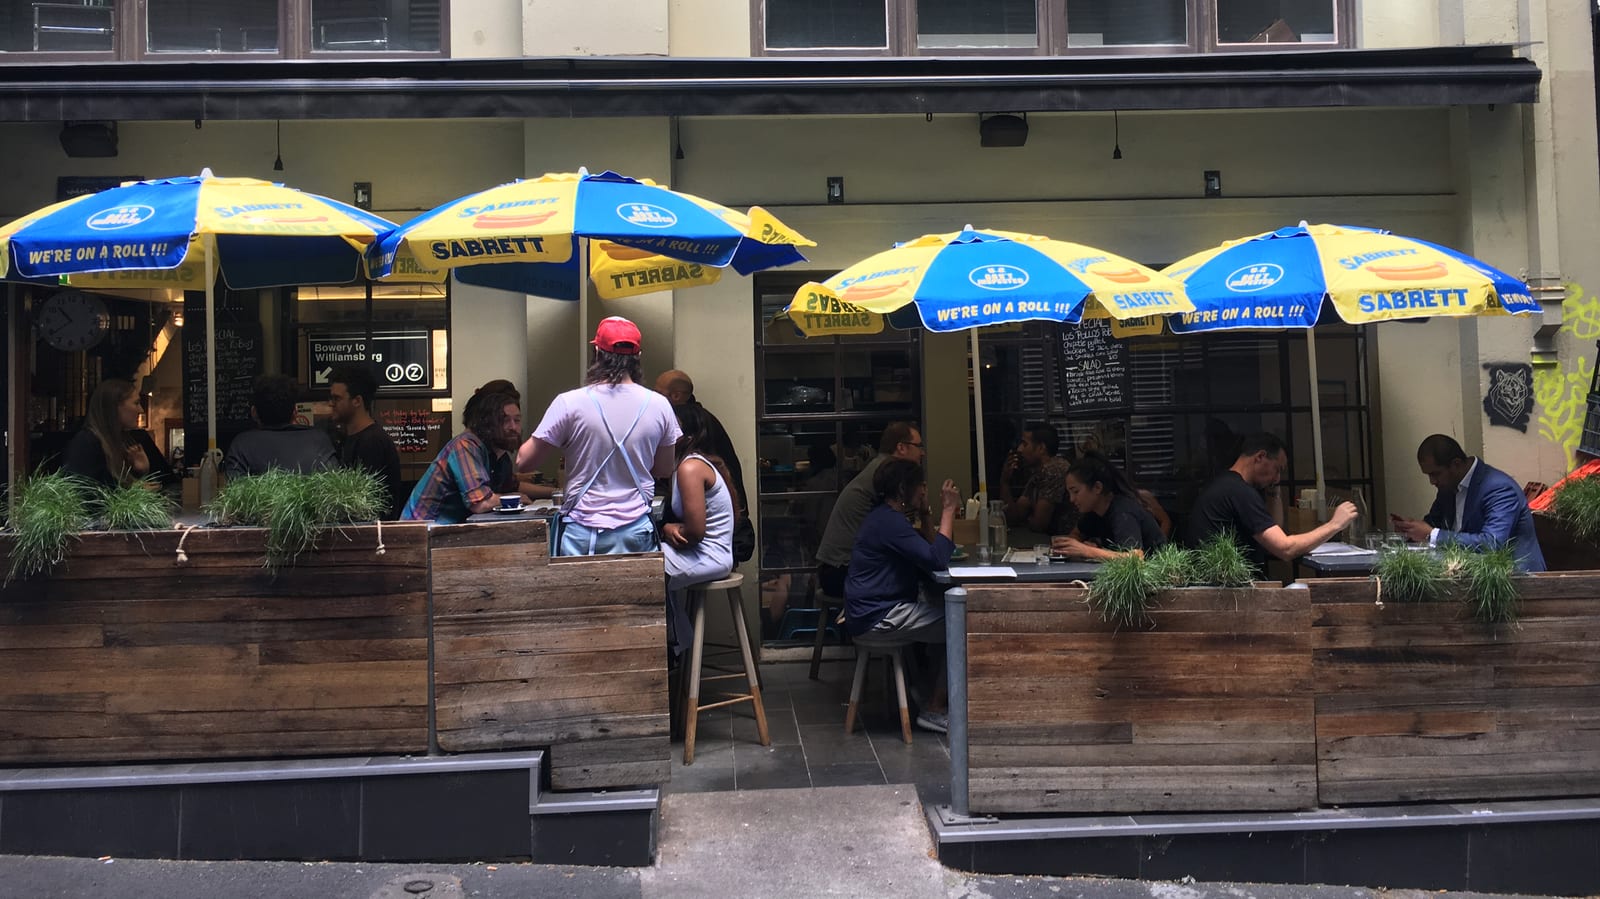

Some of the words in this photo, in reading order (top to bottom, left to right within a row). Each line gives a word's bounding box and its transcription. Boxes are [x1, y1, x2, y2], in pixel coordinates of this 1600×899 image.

[29, 249, 72, 265] WE'RE
[77, 247, 96, 261] ON
[99, 245, 109, 259] A
[113, 244, 146, 259] ROLL
[431, 236, 545, 260] SABRETT
[669, 241, 700, 254] ROLL
[1338, 249, 1418, 271] SABRETT
[1113, 290, 1178, 310] SABRETT
[1358, 288, 1469, 313] SABRETT
[937, 303, 979, 322] WE'RE
[982, 302, 1002, 316] ON
[1005, 301, 1014, 313] A
[1017, 300, 1051, 313] ROLL
[1182, 309, 1218, 325] WE'RE
[1222, 307, 1239, 320] ON
[1241, 306, 1250, 319] A
[1254, 305, 1285, 319] ROLL
[314, 343, 353, 353] Bowery
[355, 343, 366, 351] to
[315, 352, 383, 363] Williamsbrg
[391, 367, 399, 379] J
[410, 367, 419, 378] Z
[1077, 359, 1102, 372] SALAD
